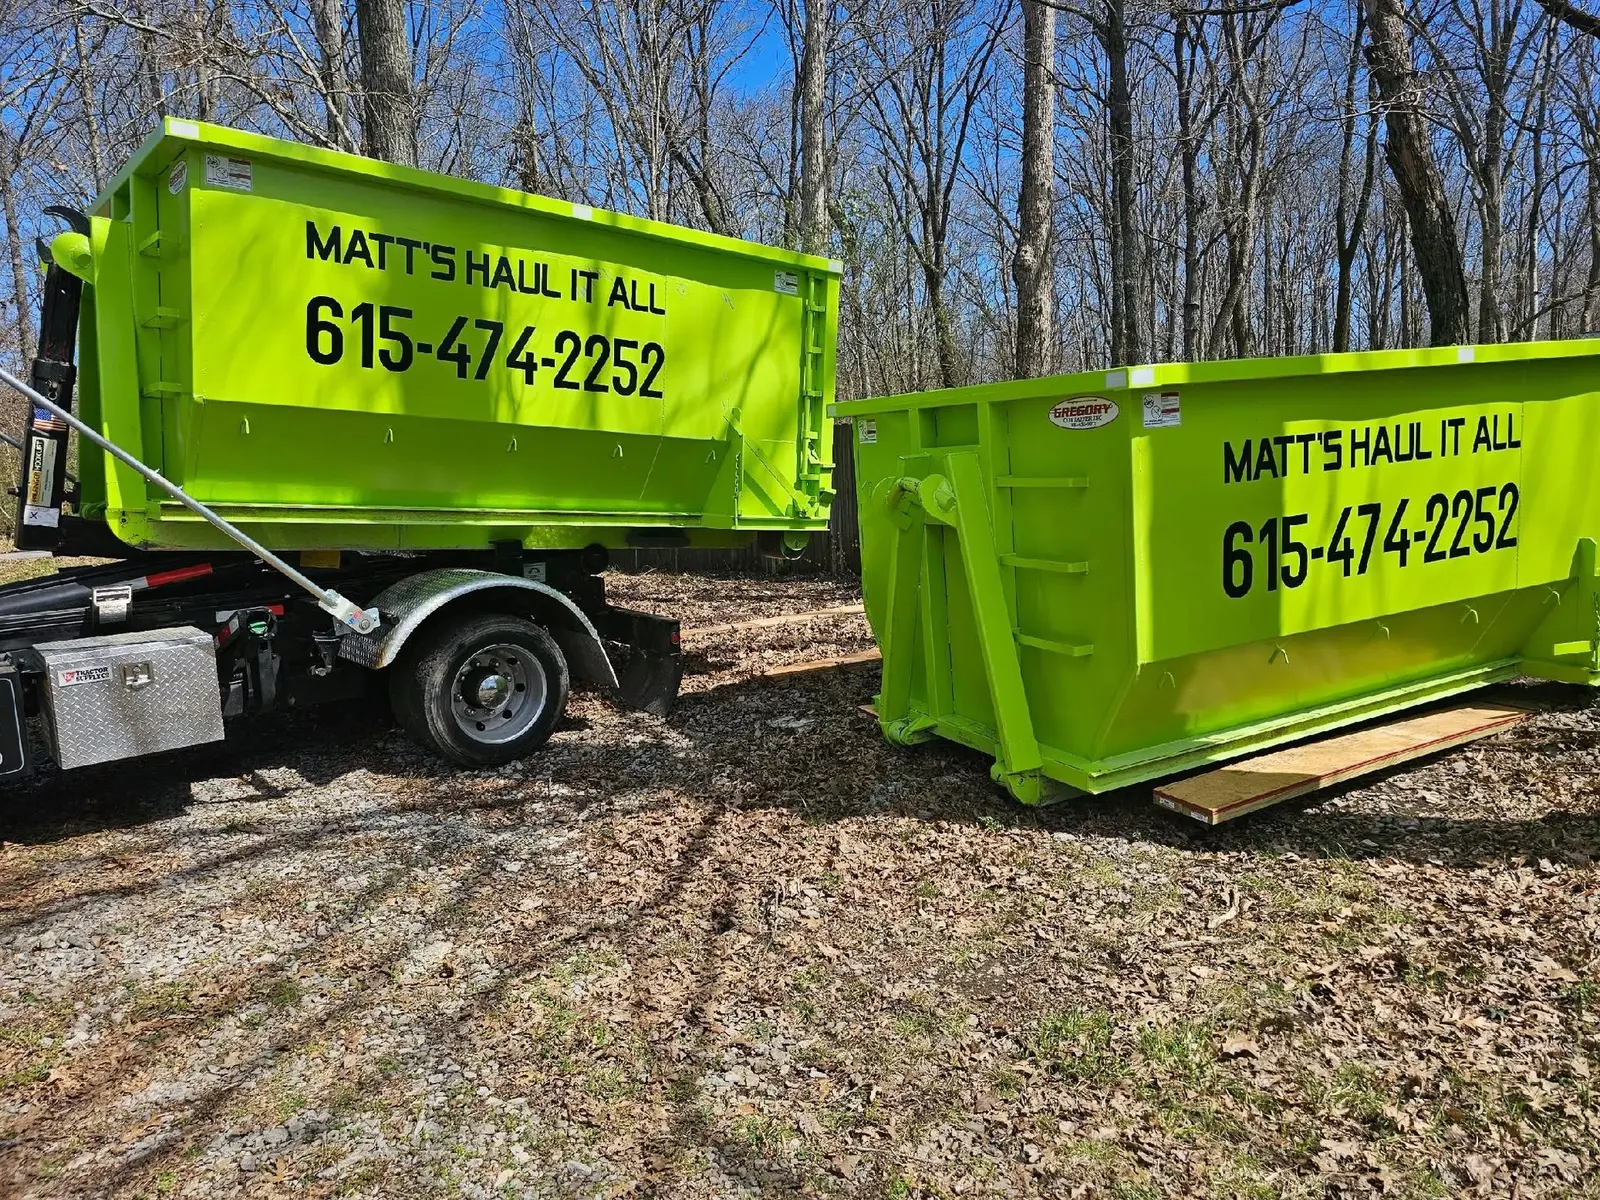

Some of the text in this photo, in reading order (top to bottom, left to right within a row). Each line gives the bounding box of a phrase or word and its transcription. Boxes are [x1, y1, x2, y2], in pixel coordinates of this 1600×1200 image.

[306, 220, 666, 315] MATT'S HAUL IT ALL
[306, 295, 665, 399] 615-474-2252
[1054, 404, 1110, 418] GREGORY
[1223, 413, 1521, 484] MATT'S HAUL IT ALL
[1222, 482, 1519, 598] 615-474-2252
[76, 667, 108, 676] TRACTOR
